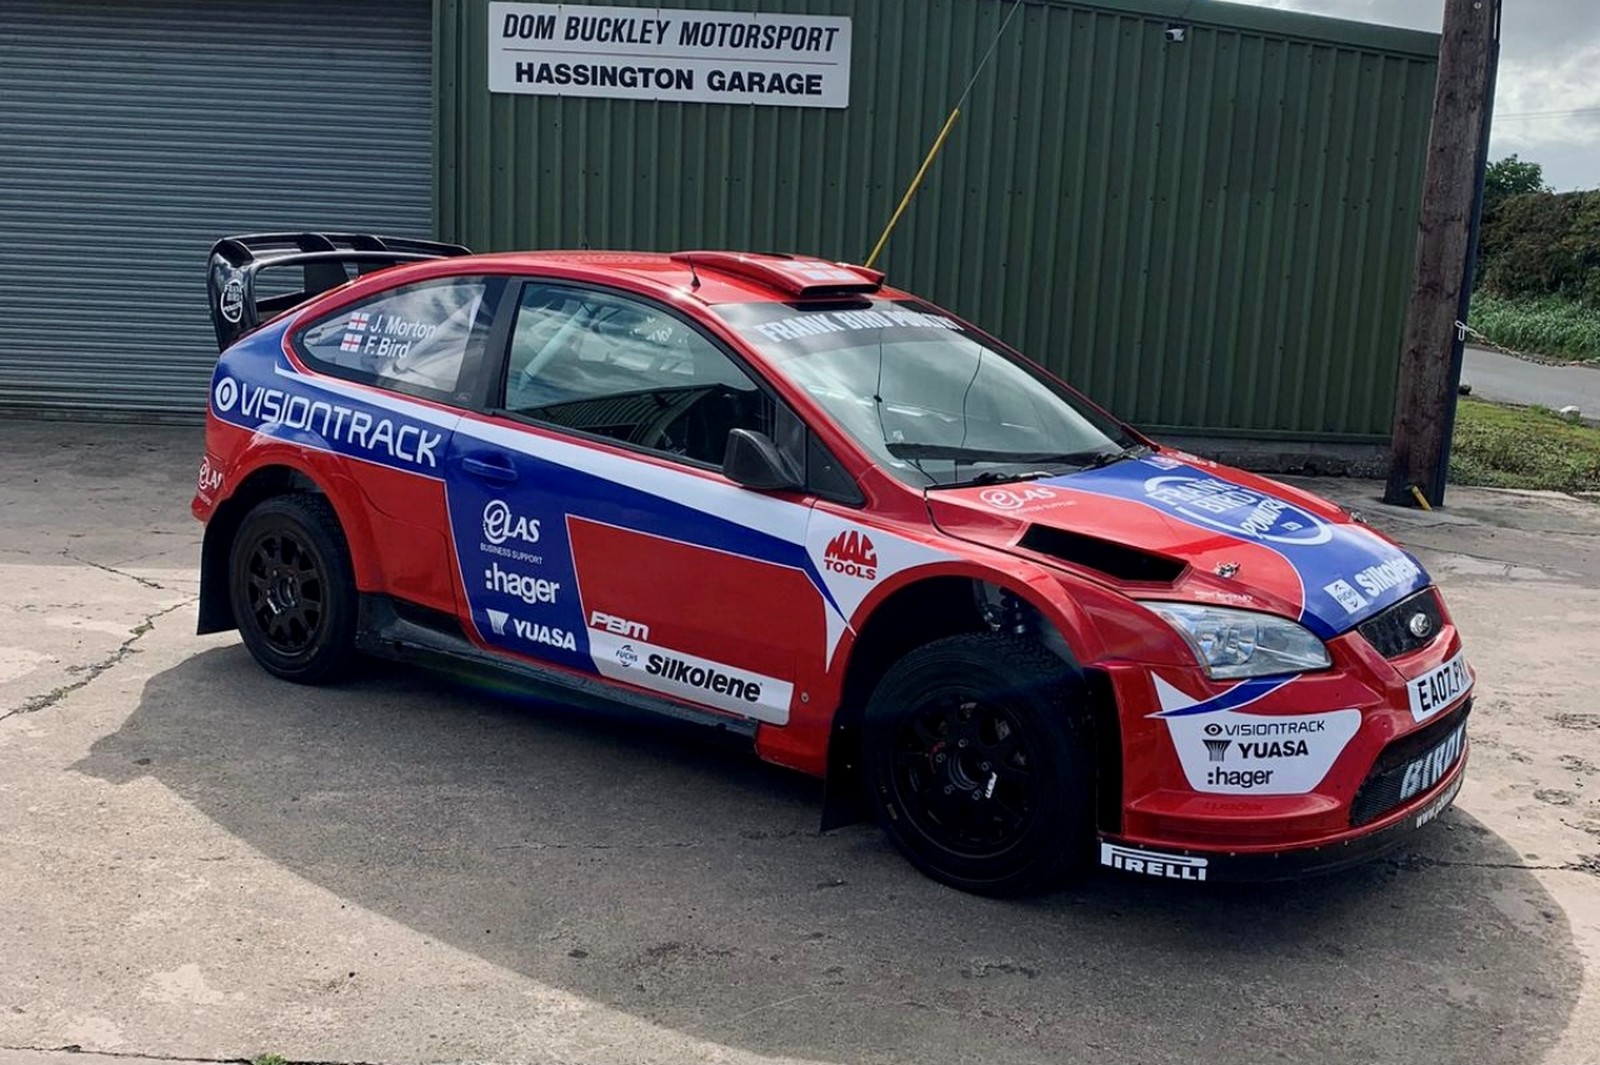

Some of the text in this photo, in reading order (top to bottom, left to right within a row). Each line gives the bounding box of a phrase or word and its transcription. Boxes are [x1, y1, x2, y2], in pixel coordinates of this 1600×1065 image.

[503, 14, 839, 52] DOM BUCKLEY MOTORSPORT
[515, 62, 823, 95] HASSINGTON GARAGE
[370, 314, 437, 339] J. Morton
[754, 313, 845, 342] FRANK
[833, 310, 894, 330] BIRD
[240, 383, 441, 467] VISIONTRACK
[1190, 490, 1257, 513] BIRD
[512, 550, 542, 565] SUPPORT
[824, 530, 877, 568] MAC
[824, 559, 876, 580] TOOLS
[513, 618, 576, 651] YUASA
[616, 650, 761, 702] FUCHS Silkolene
[1417, 665, 1453, 712] EA07
[1225, 720, 1325, 736] VISIONTRACK
[1238, 740, 1309, 759] YUASA
[1101, 843, 1208, 881] PIRELLI
